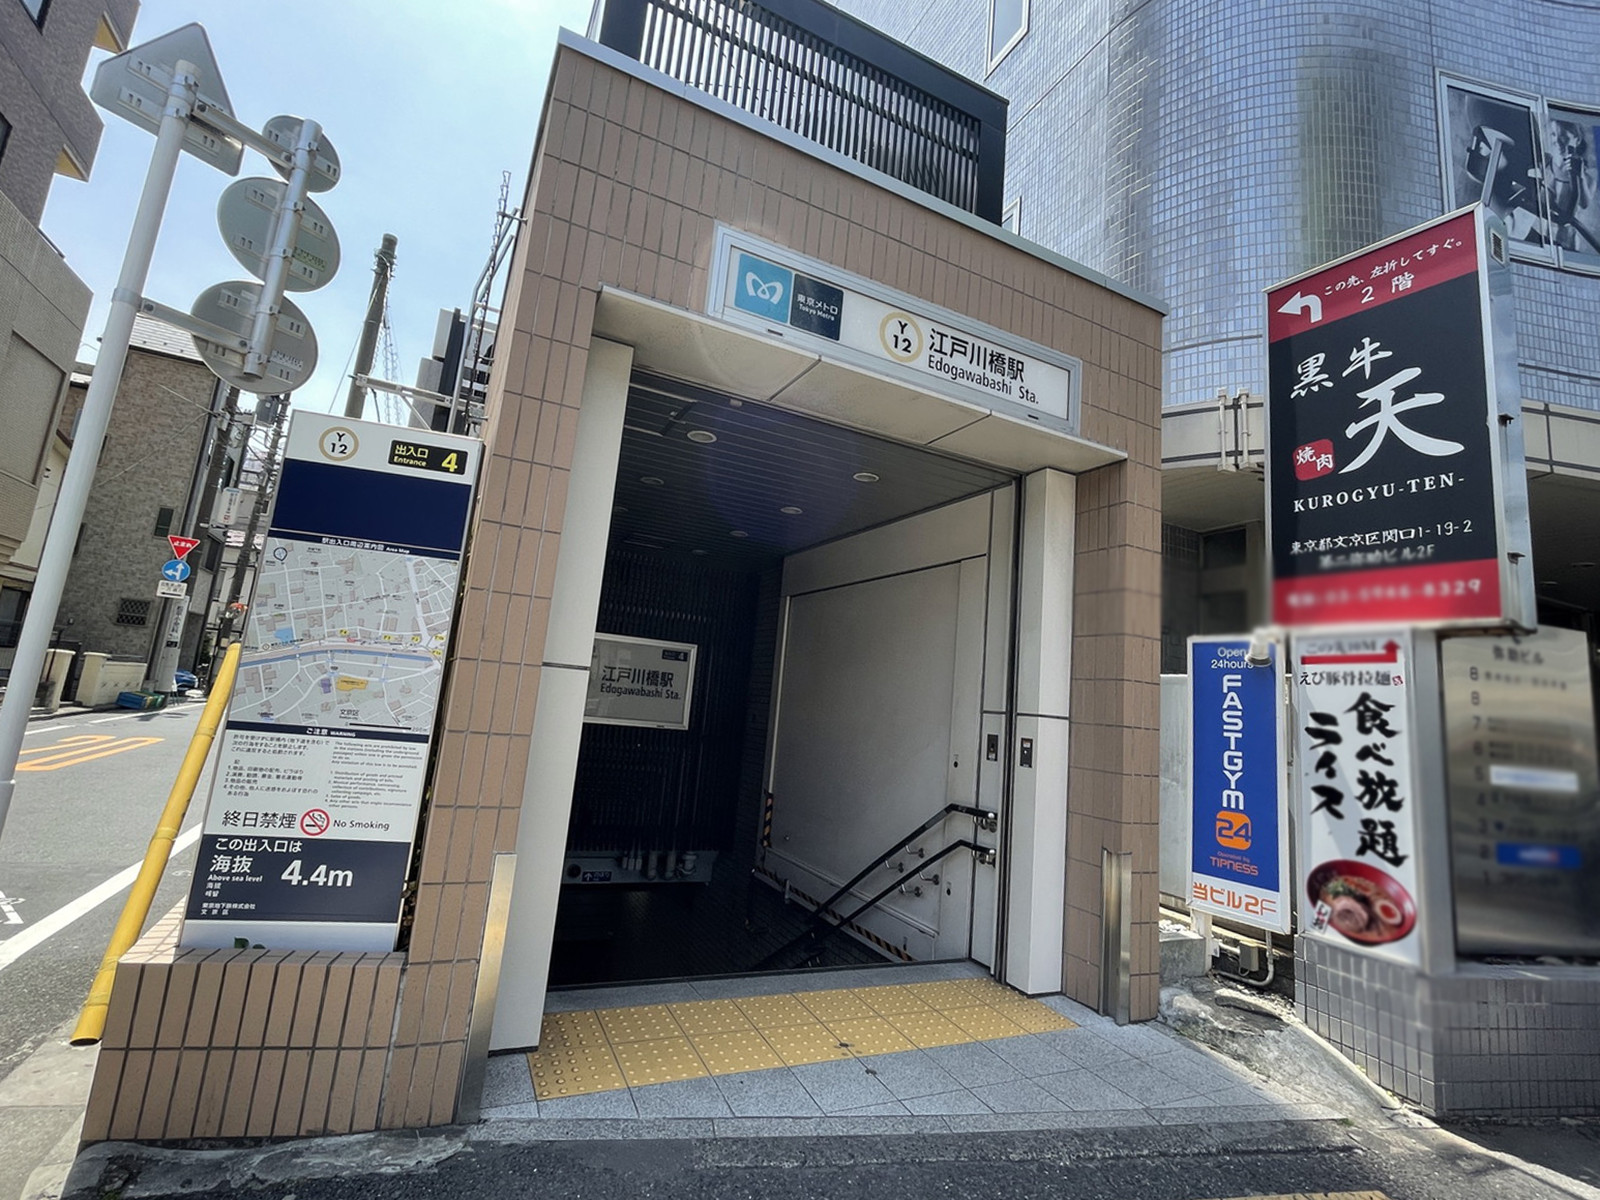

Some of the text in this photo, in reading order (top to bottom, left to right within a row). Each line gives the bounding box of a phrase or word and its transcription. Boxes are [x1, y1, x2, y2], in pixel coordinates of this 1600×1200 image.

[1324, 237, 1464, 296] この先、左折してすぐ。
[797, 294, 838, 315] 東京メトロ
[799, 304, 834, 320] Tokyo Metro
[898, 320, 908, 334] Y
[893, 334, 912, 353] 12
[928, 328, 1024, 382] 江戸川橋駅
[928, 354, 1040, 404] Edogawabashi Sta.
[336, 432, 344, 442] Y
[330, 443, 348, 454] 12
[395, 444, 428, 458] 出入口
[393, 456, 427, 466] Entrance
[441, 452, 458, 472] 4
[1296, 446, 1334, 475] 焼肉
[1290, 520, 1474, 555] 東京都文京区関口1-19-2
[1218, 646, 1246, 659] Open
[602, 666, 674, 688] 江戸川橋駅
[600, 683, 681, 700] Edogawabashi Sta.
[1304, 712, 1346, 820] ライス
[1343, 690, 1408, 868] 食べ放題
[222, 810, 298, 829] 終日禁煙
[333, 820, 390, 831] No Smoking
[1216, 818, 1252, 842] 24
[216, 838, 302, 852] この出入口は
[210, 854, 254, 873] 海抜
[280, 860, 354, 886] 4.4m
[1210, 856, 1258, 876] TIPNESS
[1193, 882, 1276, 916] 当ビル2F
